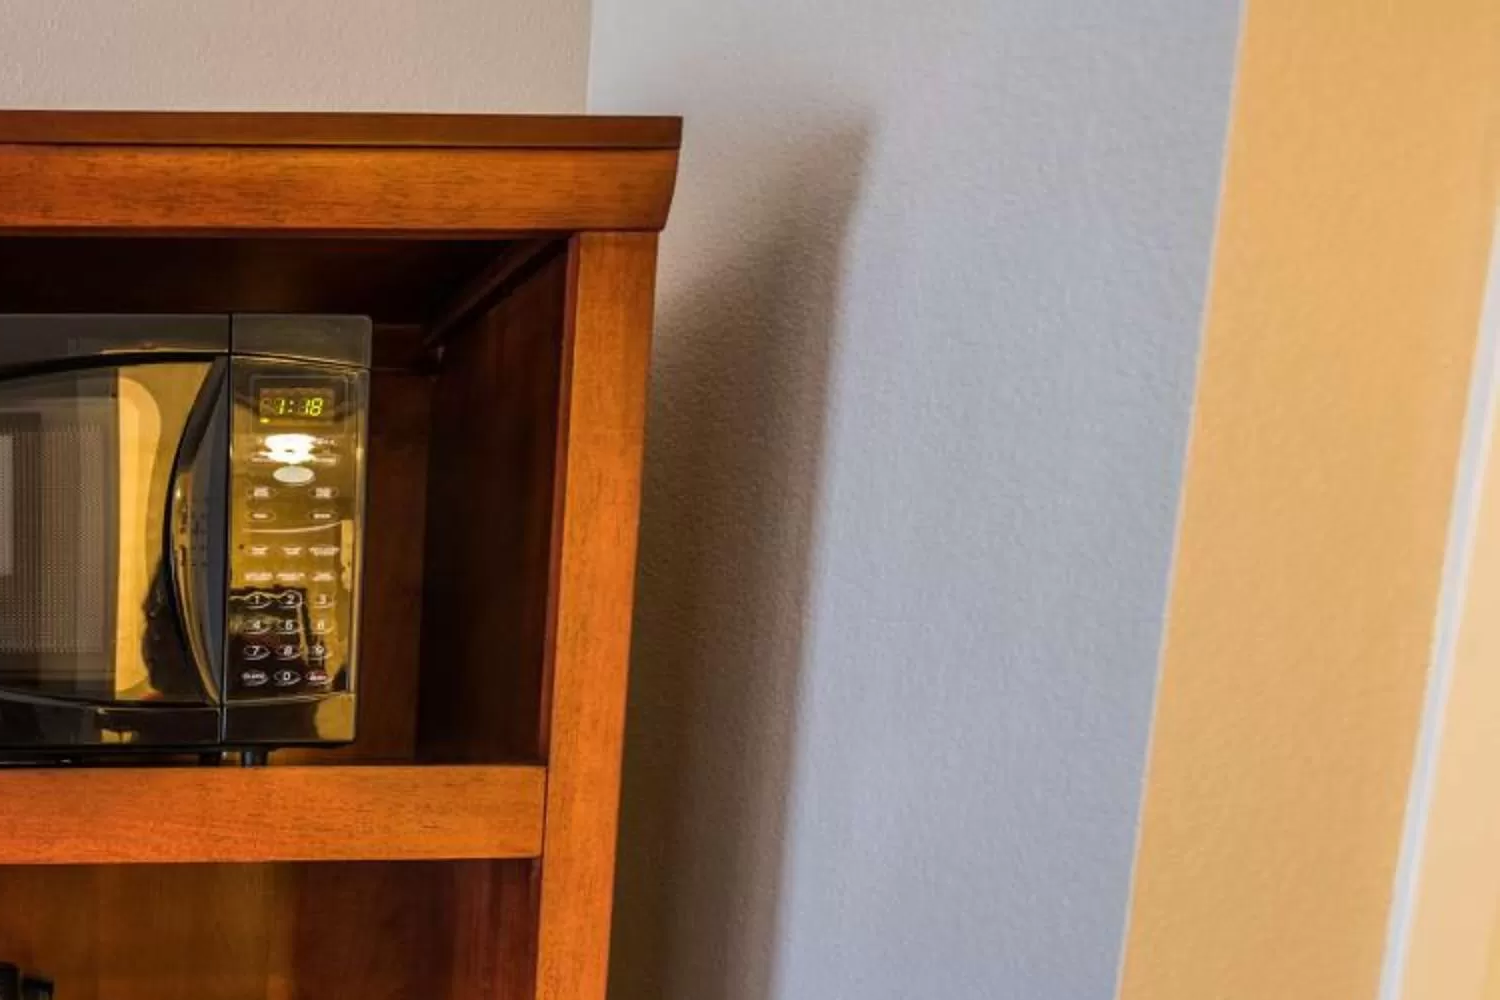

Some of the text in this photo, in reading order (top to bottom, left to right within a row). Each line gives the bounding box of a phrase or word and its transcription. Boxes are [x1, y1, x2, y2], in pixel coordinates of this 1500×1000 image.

[277, 397, 324, 417] 1:18
[286, 594, 294, 605] 2
[252, 620, 261, 629] 4
[252, 645, 261, 656] 7
[283, 645, 292, 657] 8
